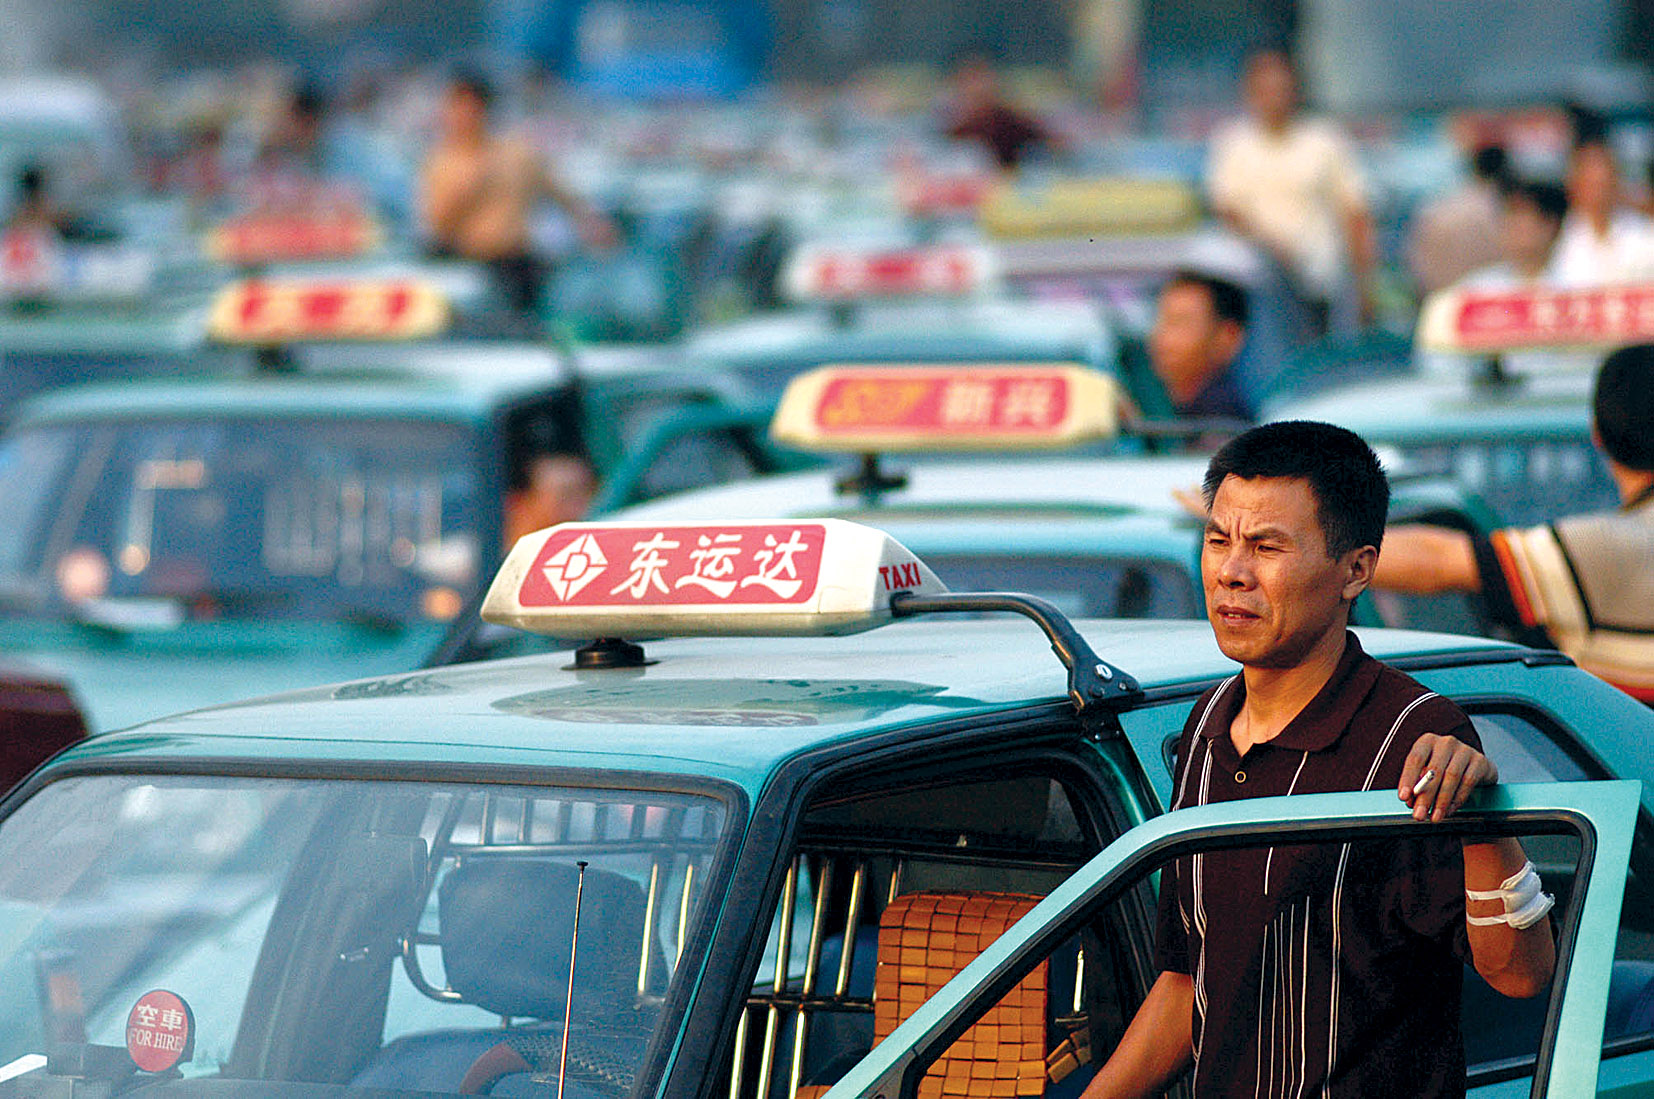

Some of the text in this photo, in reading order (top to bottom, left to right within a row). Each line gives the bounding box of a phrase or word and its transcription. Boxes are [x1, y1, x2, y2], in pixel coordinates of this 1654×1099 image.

[610, 530, 808, 600] 东运达
[878, 562, 922, 591] TAXI
[136, 1004, 184, 1031] 空車
[128, 1026, 184, 1053] FOR HIRE
